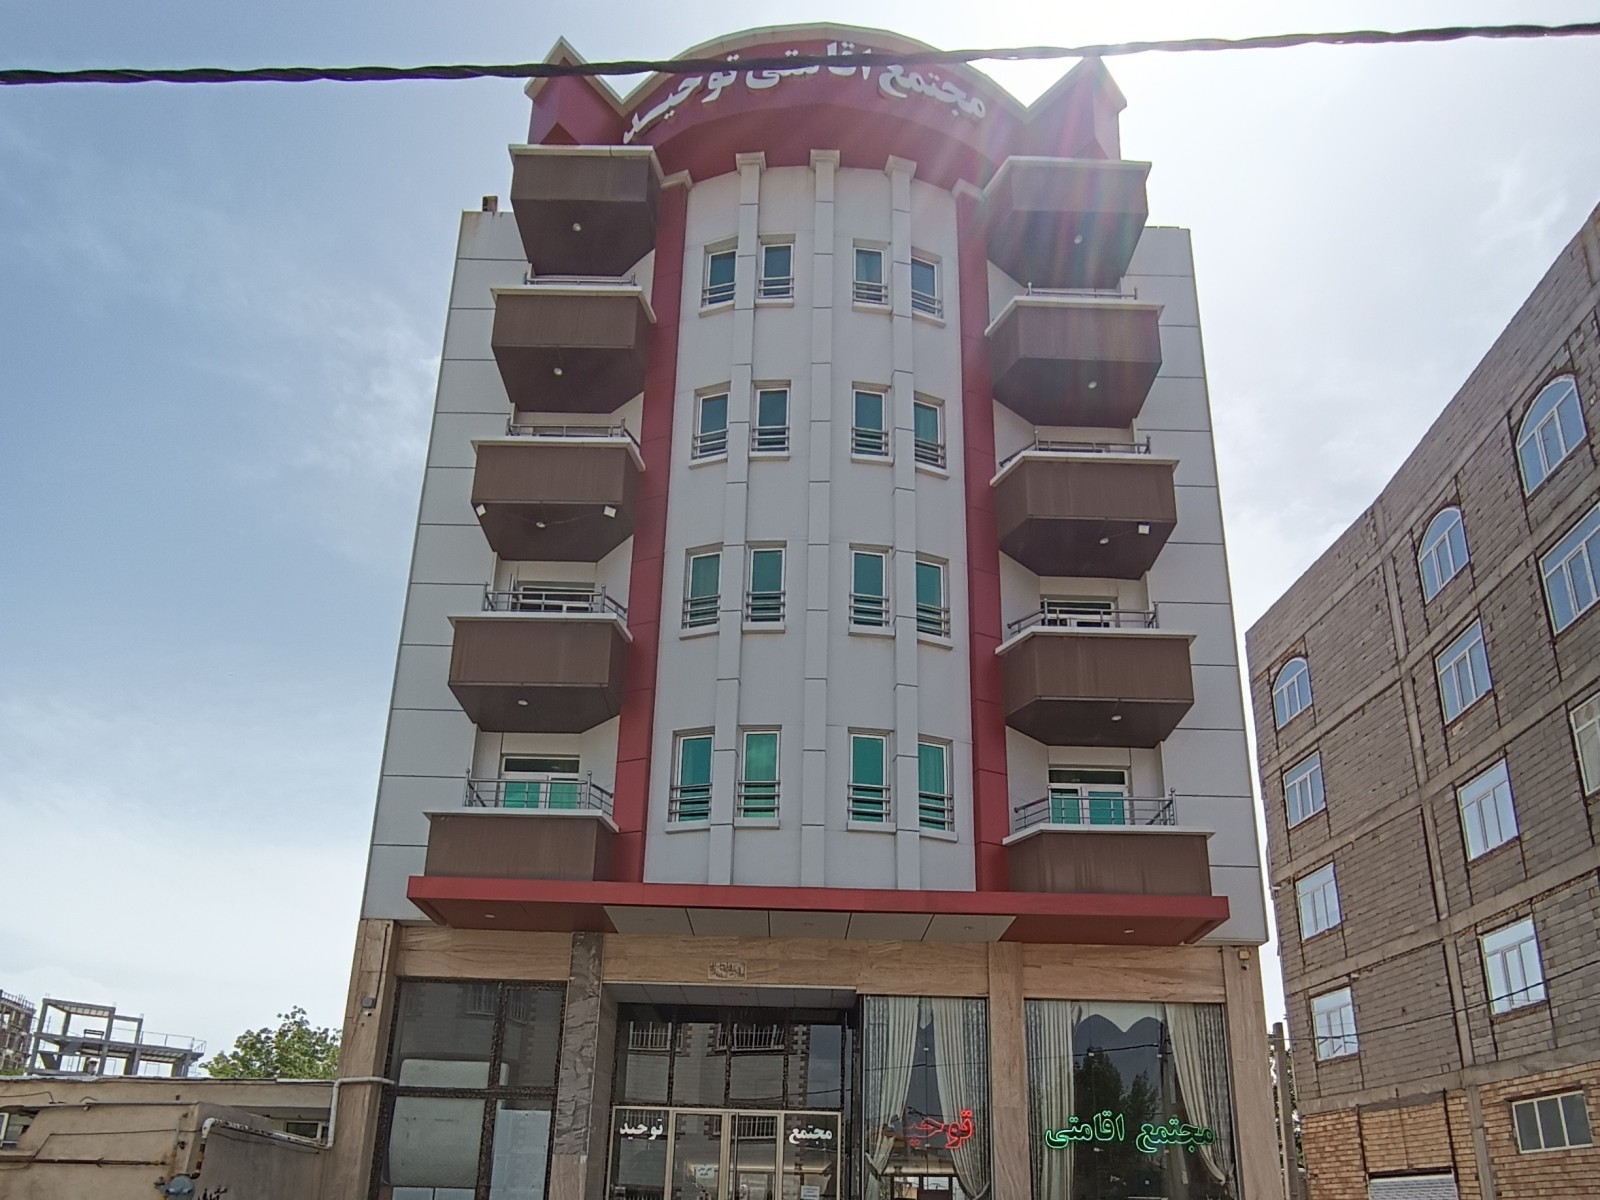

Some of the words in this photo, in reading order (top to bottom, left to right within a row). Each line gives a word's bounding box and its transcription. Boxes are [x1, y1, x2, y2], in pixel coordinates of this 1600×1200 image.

[623, 54, 739, 144] توحید
[880, 64, 987, 119] مجتمع
[620, 1118, 664, 1140] توحید
[789, 1125, 833, 1144] مجتمع
[902, 1109, 973, 1149] توحی
[1045, 1110, 1126, 1149] اقامتی
[1136, 1116, 1214, 1153] مجتمع
